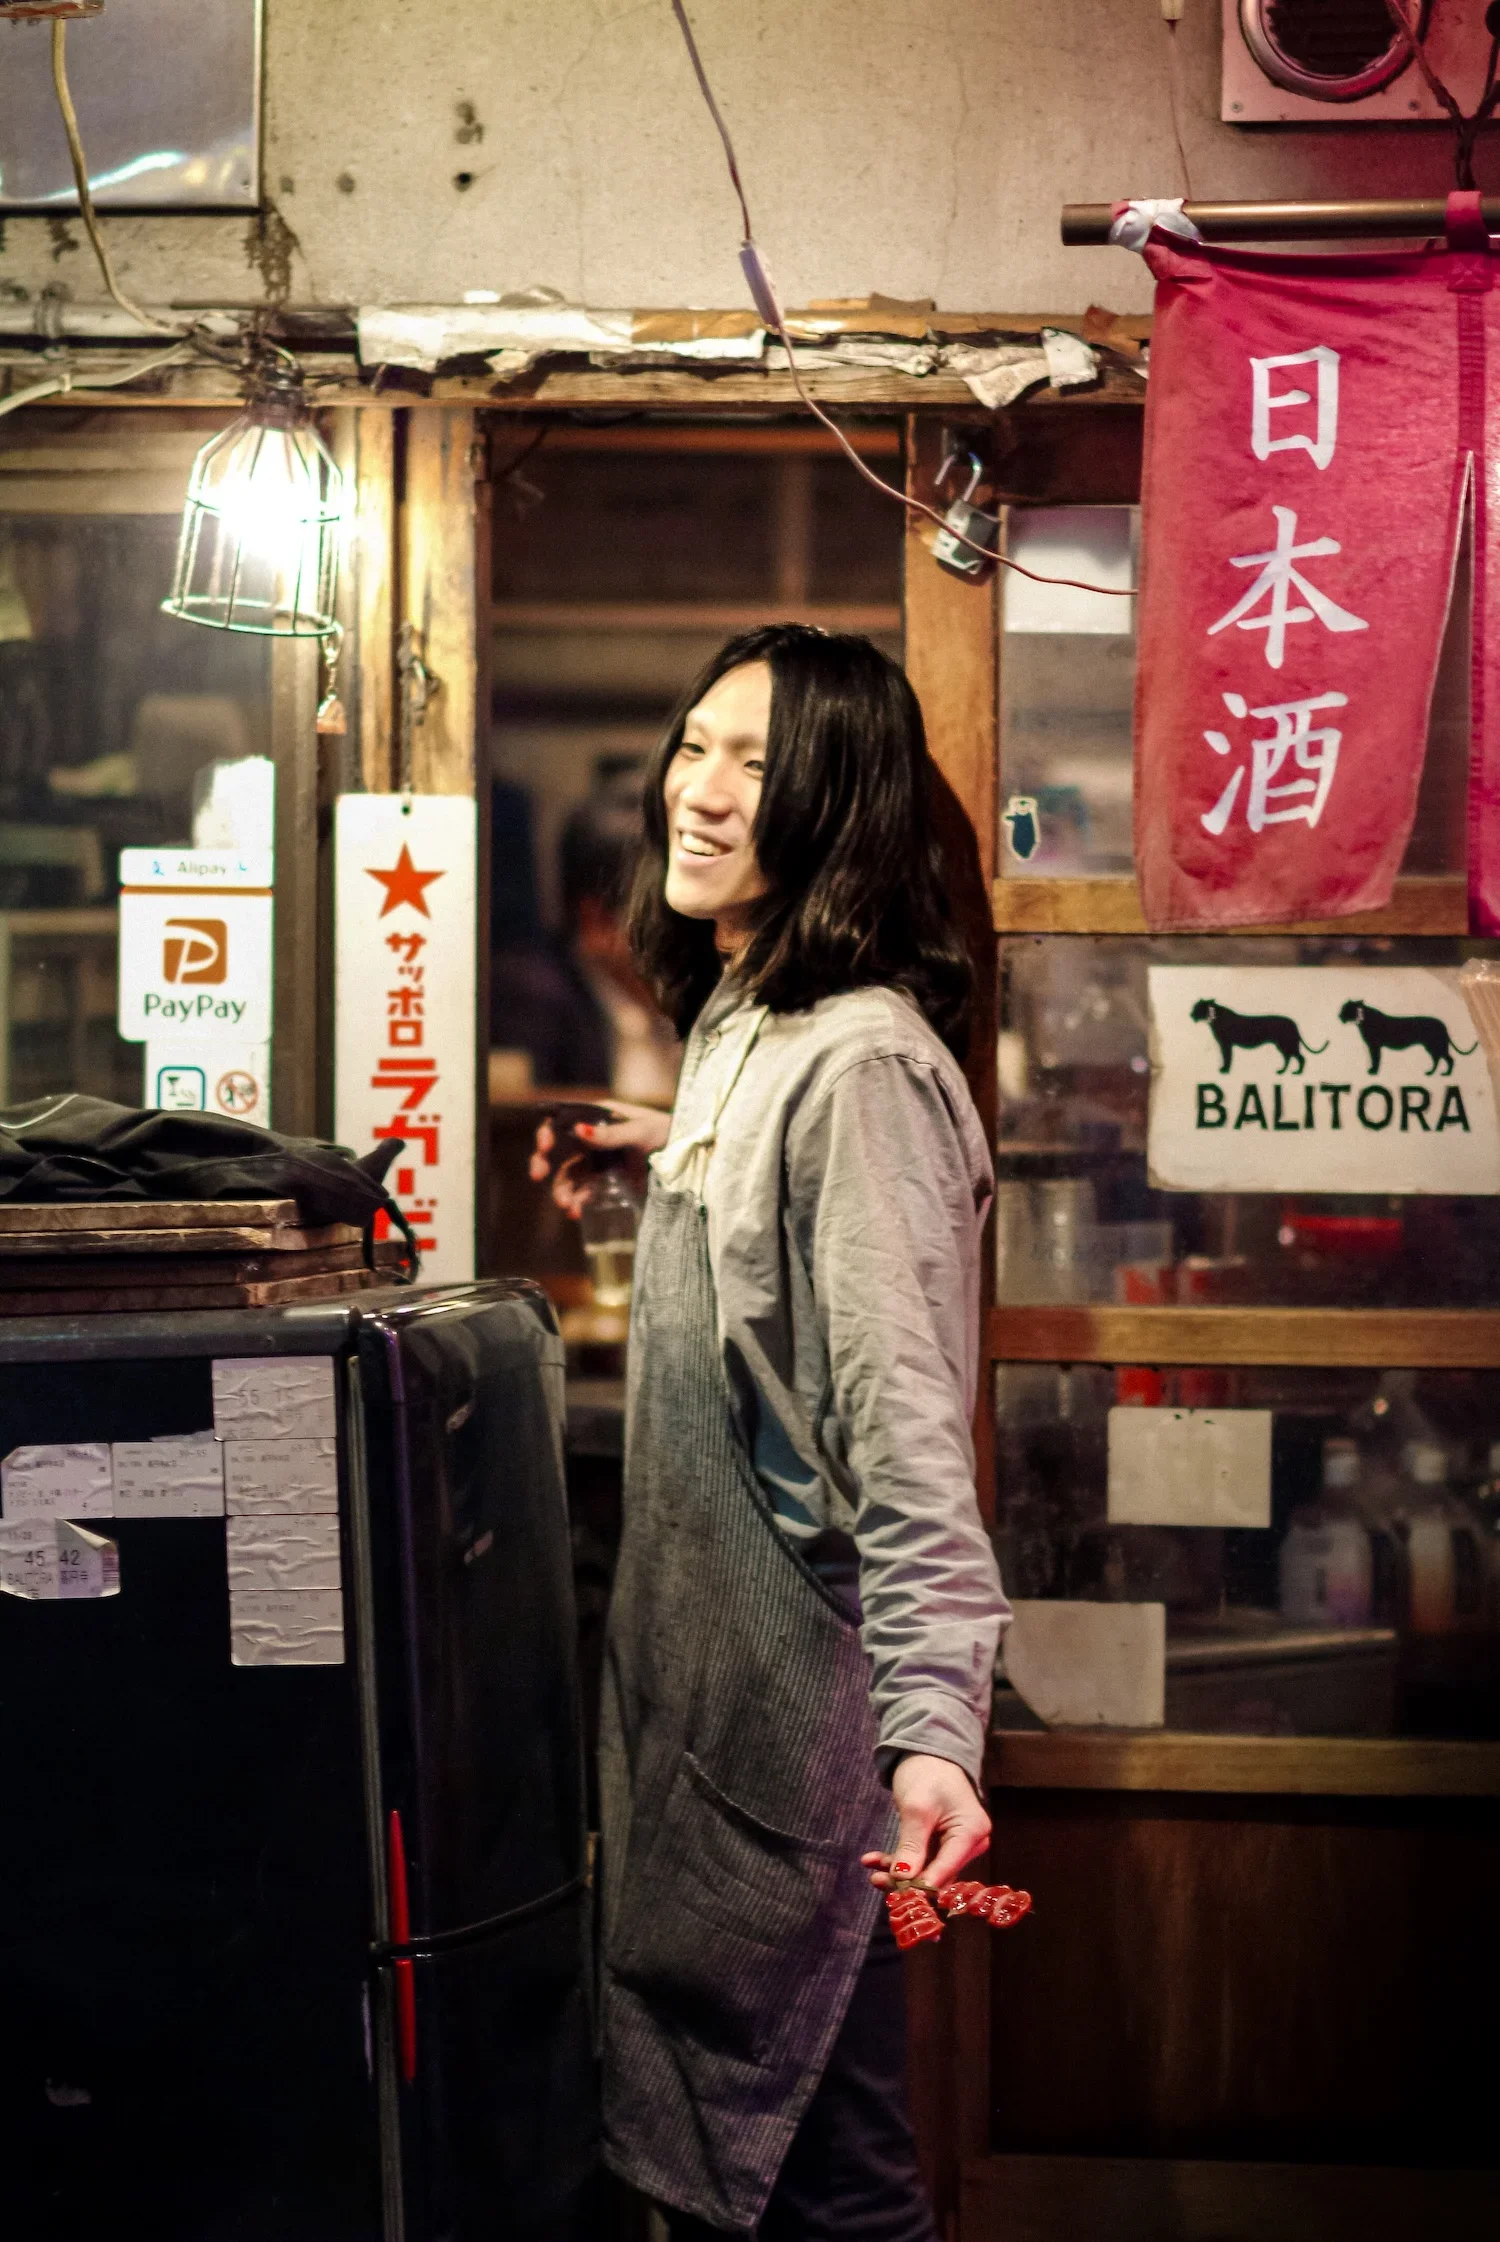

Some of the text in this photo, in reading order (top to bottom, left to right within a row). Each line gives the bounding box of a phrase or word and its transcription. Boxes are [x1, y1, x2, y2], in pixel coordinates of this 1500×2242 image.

[1203, 344, 1369, 836] 日本酒
[177, 861, 227, 876] Alipay
[144, 993, 247, 1024] PayPay
[1196, 1082, 1471, 1132] BALITORA
[59, 1549, 81, 1566] 42
